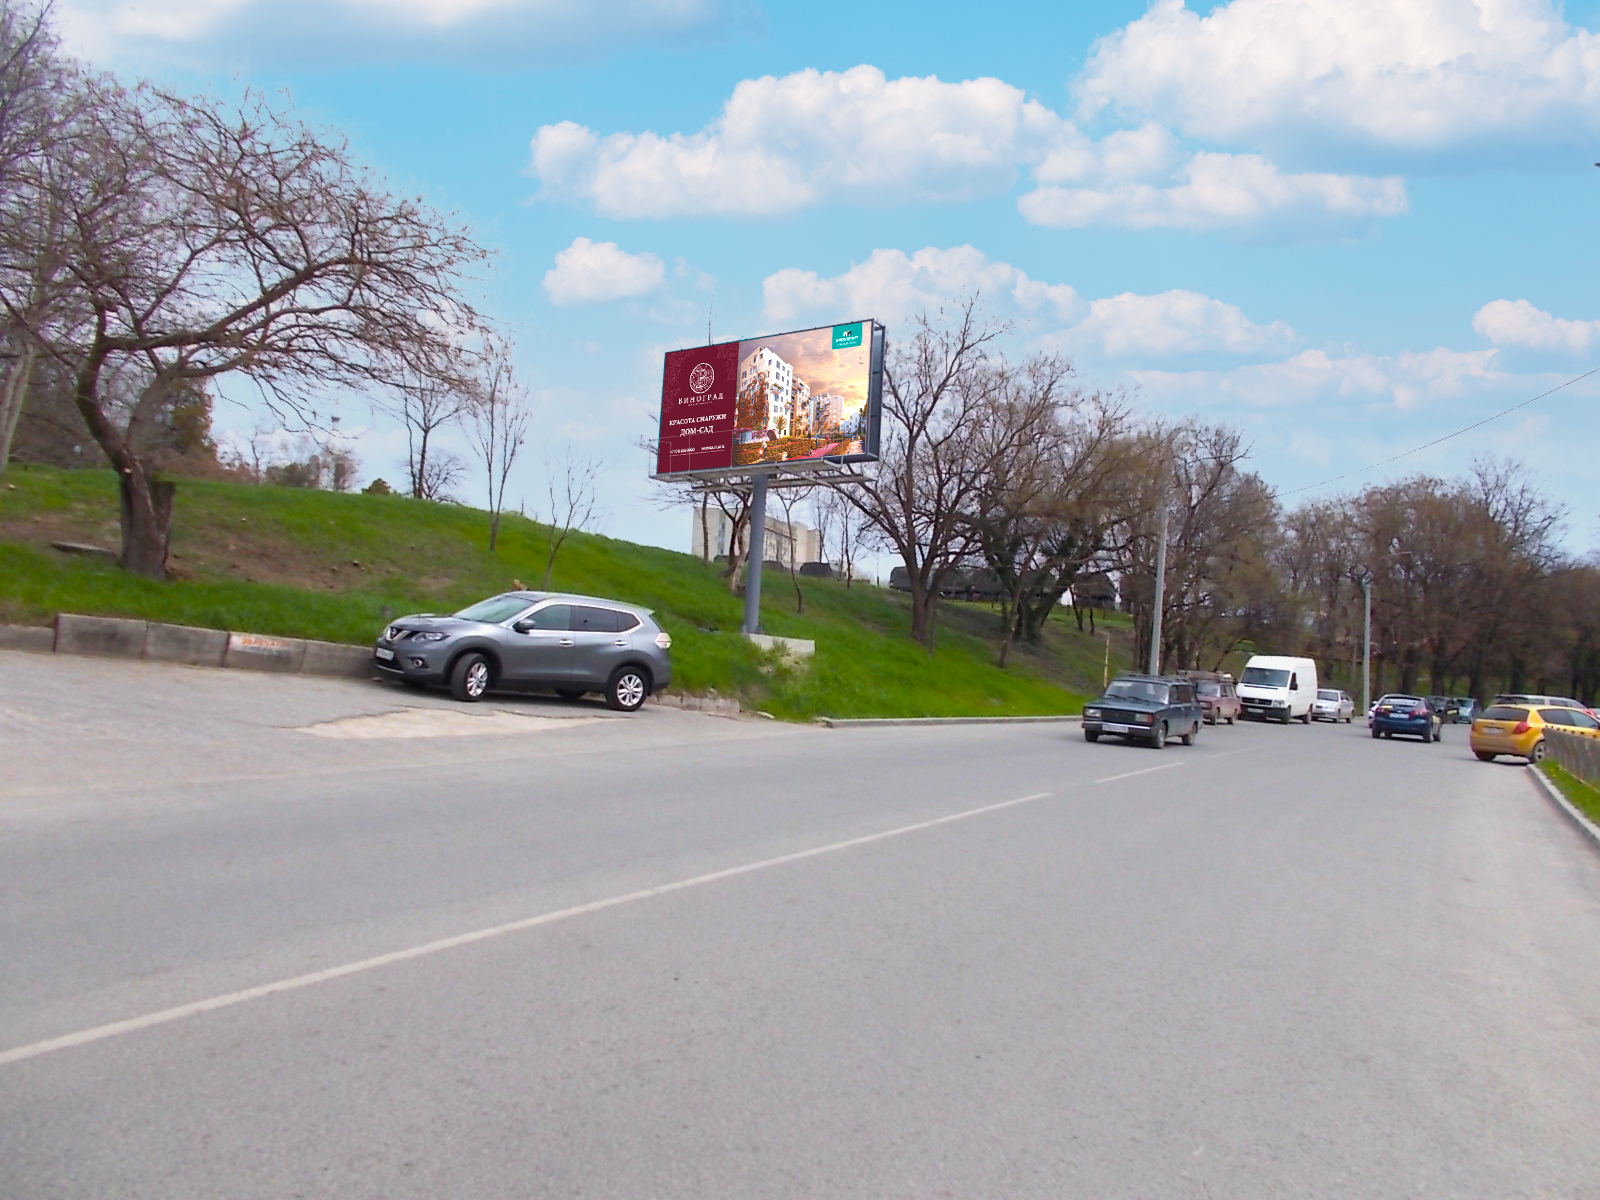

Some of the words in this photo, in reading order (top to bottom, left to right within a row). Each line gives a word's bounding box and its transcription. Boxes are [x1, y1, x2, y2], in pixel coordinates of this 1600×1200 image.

[678, 392, 724, 404] ВИНОГРАД
[669, 418, 696, 426] КРАСОТА
[696, 413, 727, 423] СНАРУЖИ
[680, 425, 714, 437] ДОМ-САД
